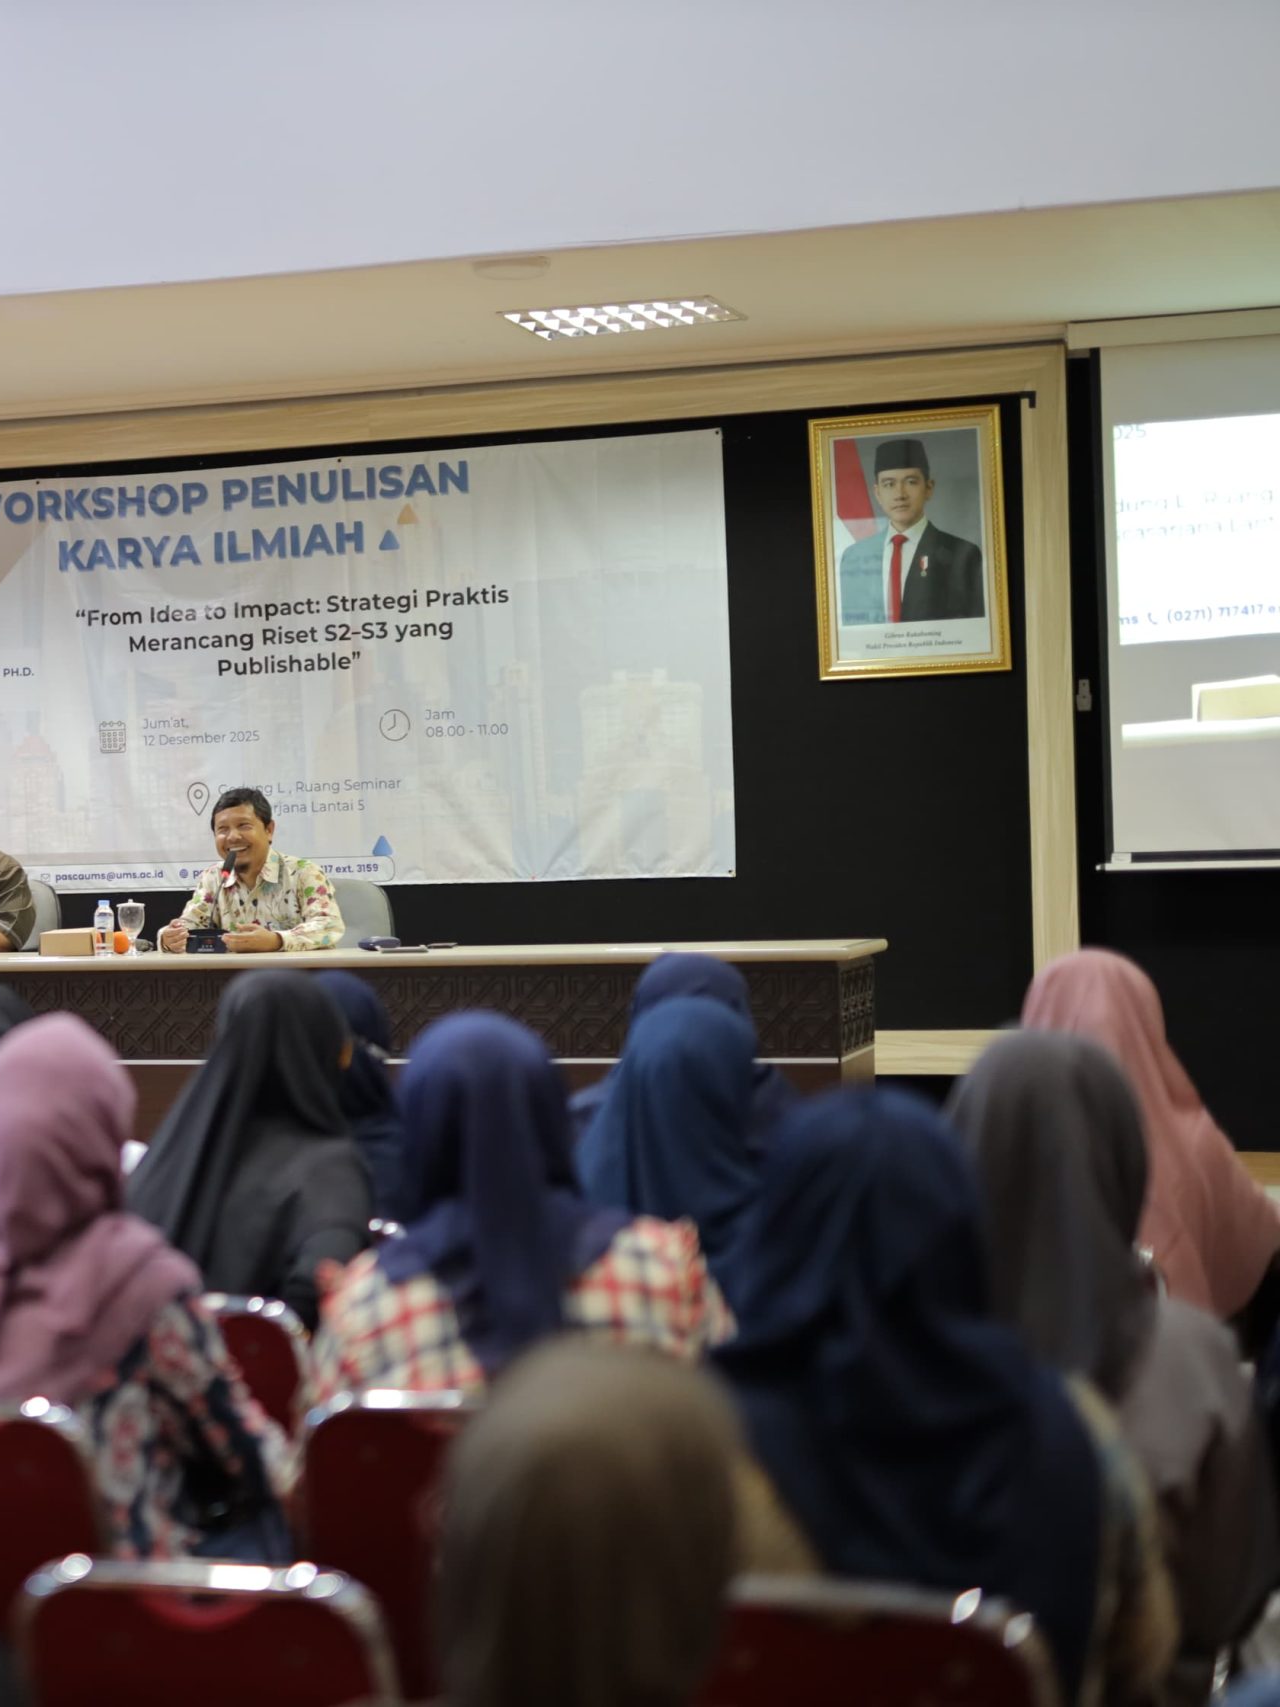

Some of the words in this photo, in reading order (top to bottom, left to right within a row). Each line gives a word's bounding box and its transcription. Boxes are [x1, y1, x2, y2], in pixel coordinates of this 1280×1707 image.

[222, 460, 469, 511] PENULISAN
[58, 535, 202, 572] KARYA
[213, 521, 365, 564] ILMIAH
[75, 608, 143, 627] “From
[150, 605, 197, 624] Idea
[204, 604, 227, 620] to
[233, 597, 321, 621] Impact:
[326, 590, 418, 614] Strategi
[425, 584, 510, 608] Praktis
[129, 632, 254, 652] Merancang
[261, 625, 318, 646] Riset
[394, 621, 454, 643] yang
[3, 666, 35, 677] PH.D.
[217, 650, 362, 677] Publishable”
[424, 708, 456, 721] Jam
[144, 735, 155, 746] 12
[159, 732, 226, 746] Desember
[229, 730, 260, 743] 2025
[425, 725, 466, 738] 08.00
[477, 723, 509, 736] 11.00
[295, 780, 340, 794] Ruang
[343, 777, 402, 791] Seminar
[311, 799, 354, 813] Lantai
[55, 869, 164, 883] pascaums@ums.ac.id
[335, 864, 353, 873] ext.
[357, 863, 379, 873] 3159
